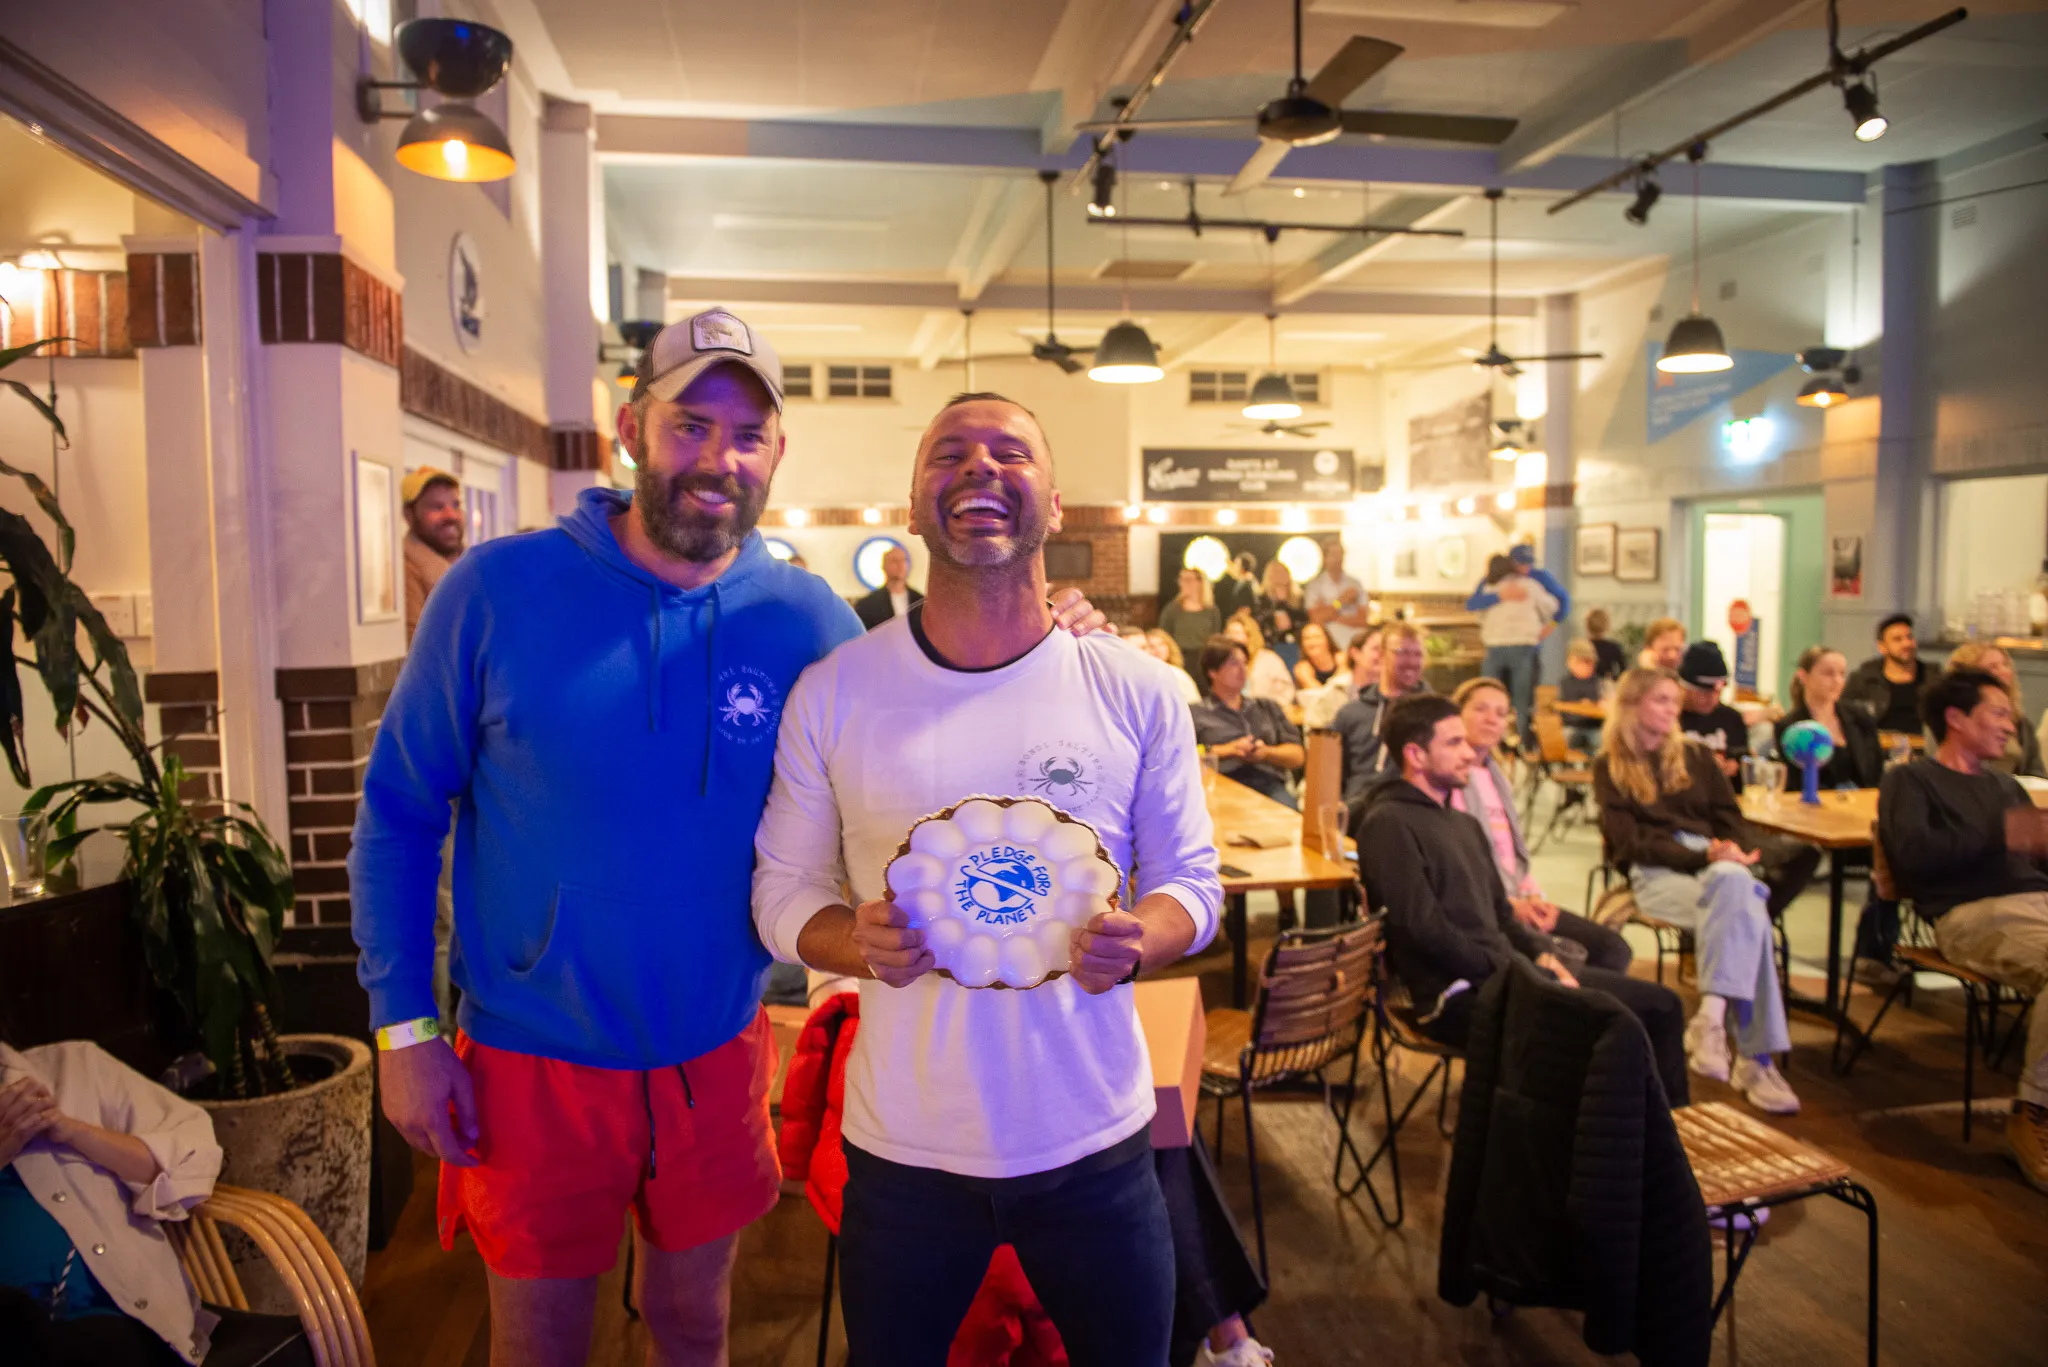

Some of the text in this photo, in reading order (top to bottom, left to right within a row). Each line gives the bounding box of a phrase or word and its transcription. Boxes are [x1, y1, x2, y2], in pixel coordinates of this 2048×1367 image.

[969, 846, 1051, 888] PLEDGE FOR
[954, 880, 1036, 924] THE PLANET
